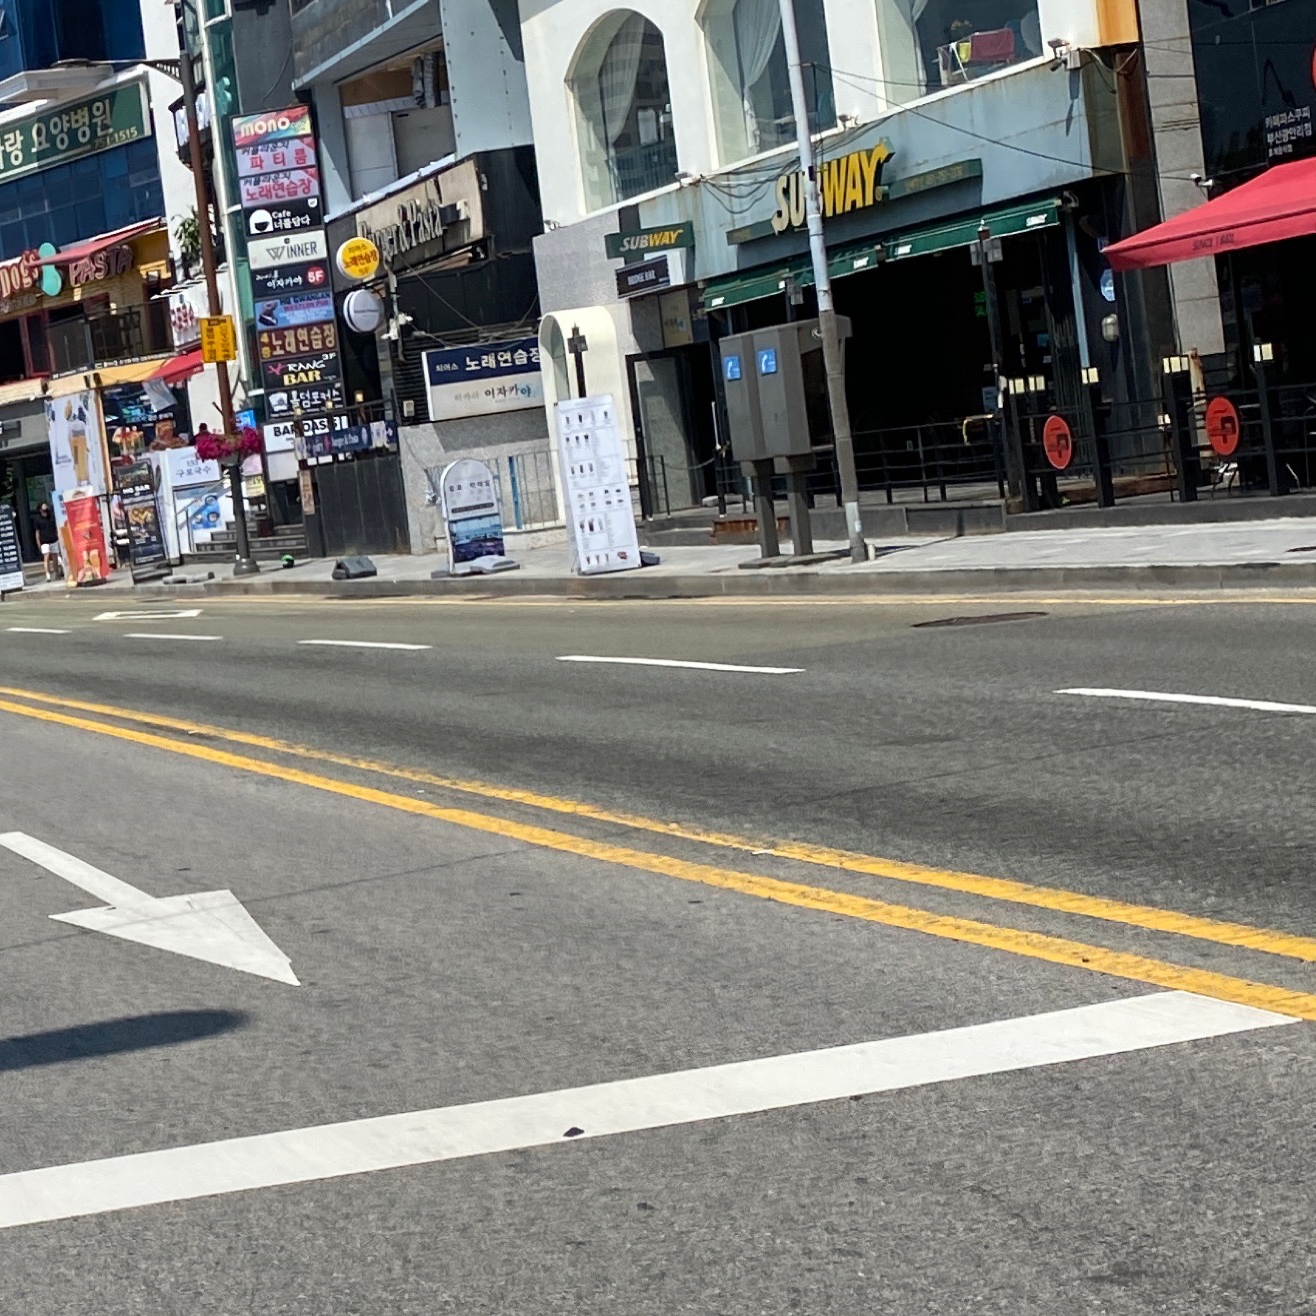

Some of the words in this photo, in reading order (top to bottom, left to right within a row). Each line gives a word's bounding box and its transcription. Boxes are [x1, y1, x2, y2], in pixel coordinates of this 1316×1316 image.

[31, 98, 114, 153] 요양병원
[240, 116, 290, 138] mono
[94, 126, 138, 150] 751-1515
[246, 178, 313, 202] 노래연습장
[771, 140, 894, 236] SUWAY
[272, 209, 292, 219] Cafe
[266, 241, 318, 261] WINNER
[619, 229, 684, 252] SUBWAY
[68, 245, 134, 287] PASTA
[307, 270, 324, 283] 5F
[272, 324, 336, 356] 노래연습장
[322, 352, 336, 361] 3F
[465, 347, 541, 371] 노래연습장
[284, 369, 322, 386] BAR
[484, 384, 533, 399] 이자카야
